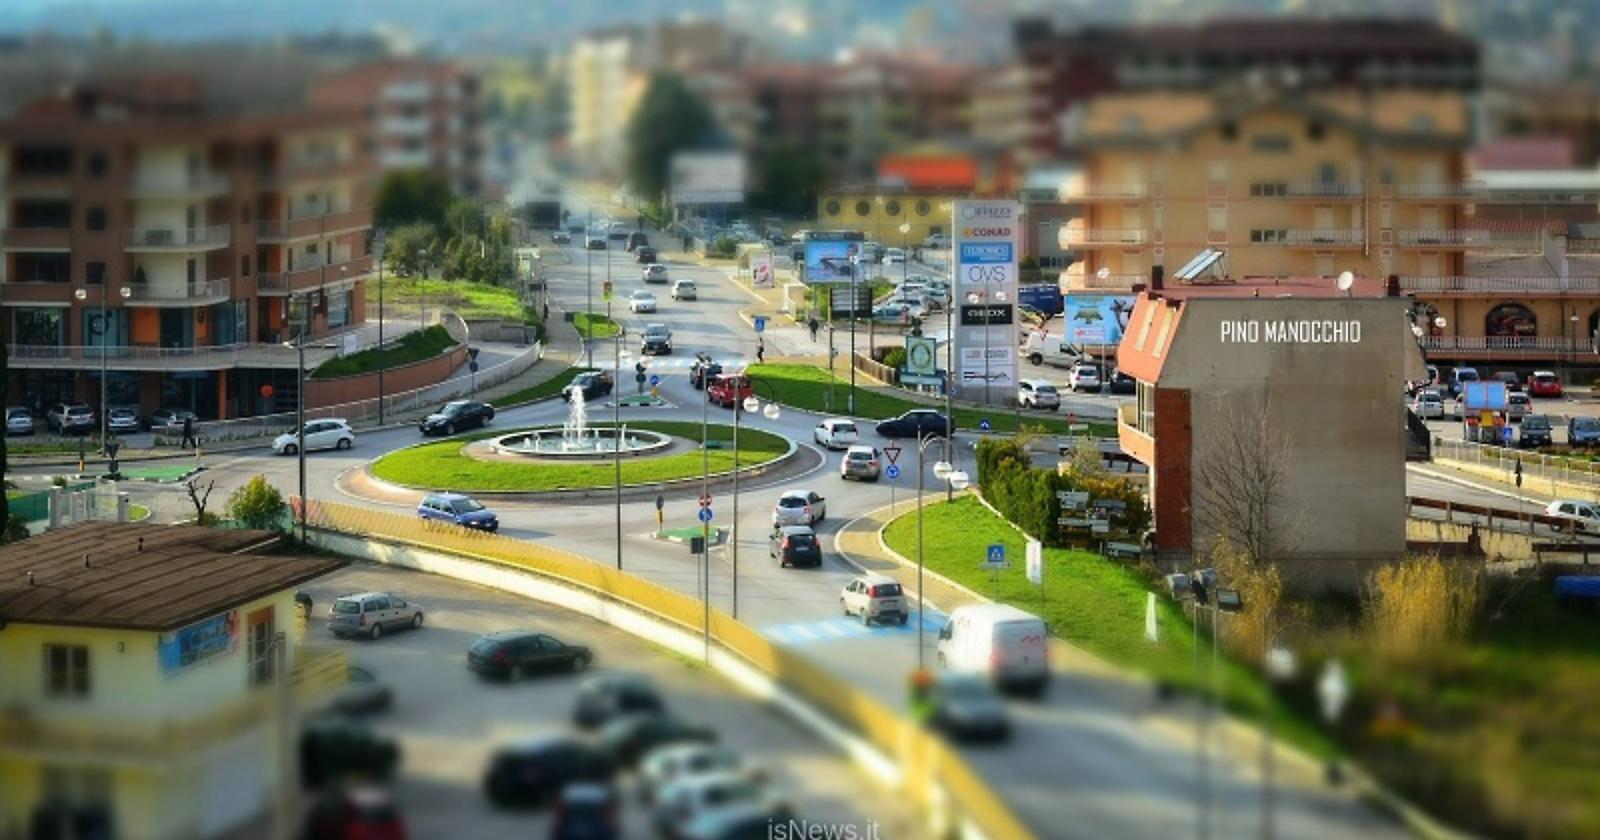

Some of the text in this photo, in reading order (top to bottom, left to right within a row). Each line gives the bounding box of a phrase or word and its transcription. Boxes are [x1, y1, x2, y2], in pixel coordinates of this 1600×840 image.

[973, 227, 1011, 237] CONAD
[968, 265, 1006, 282] OVS
[1220, 320, 1361, 343] PINO MANOCCHIO
